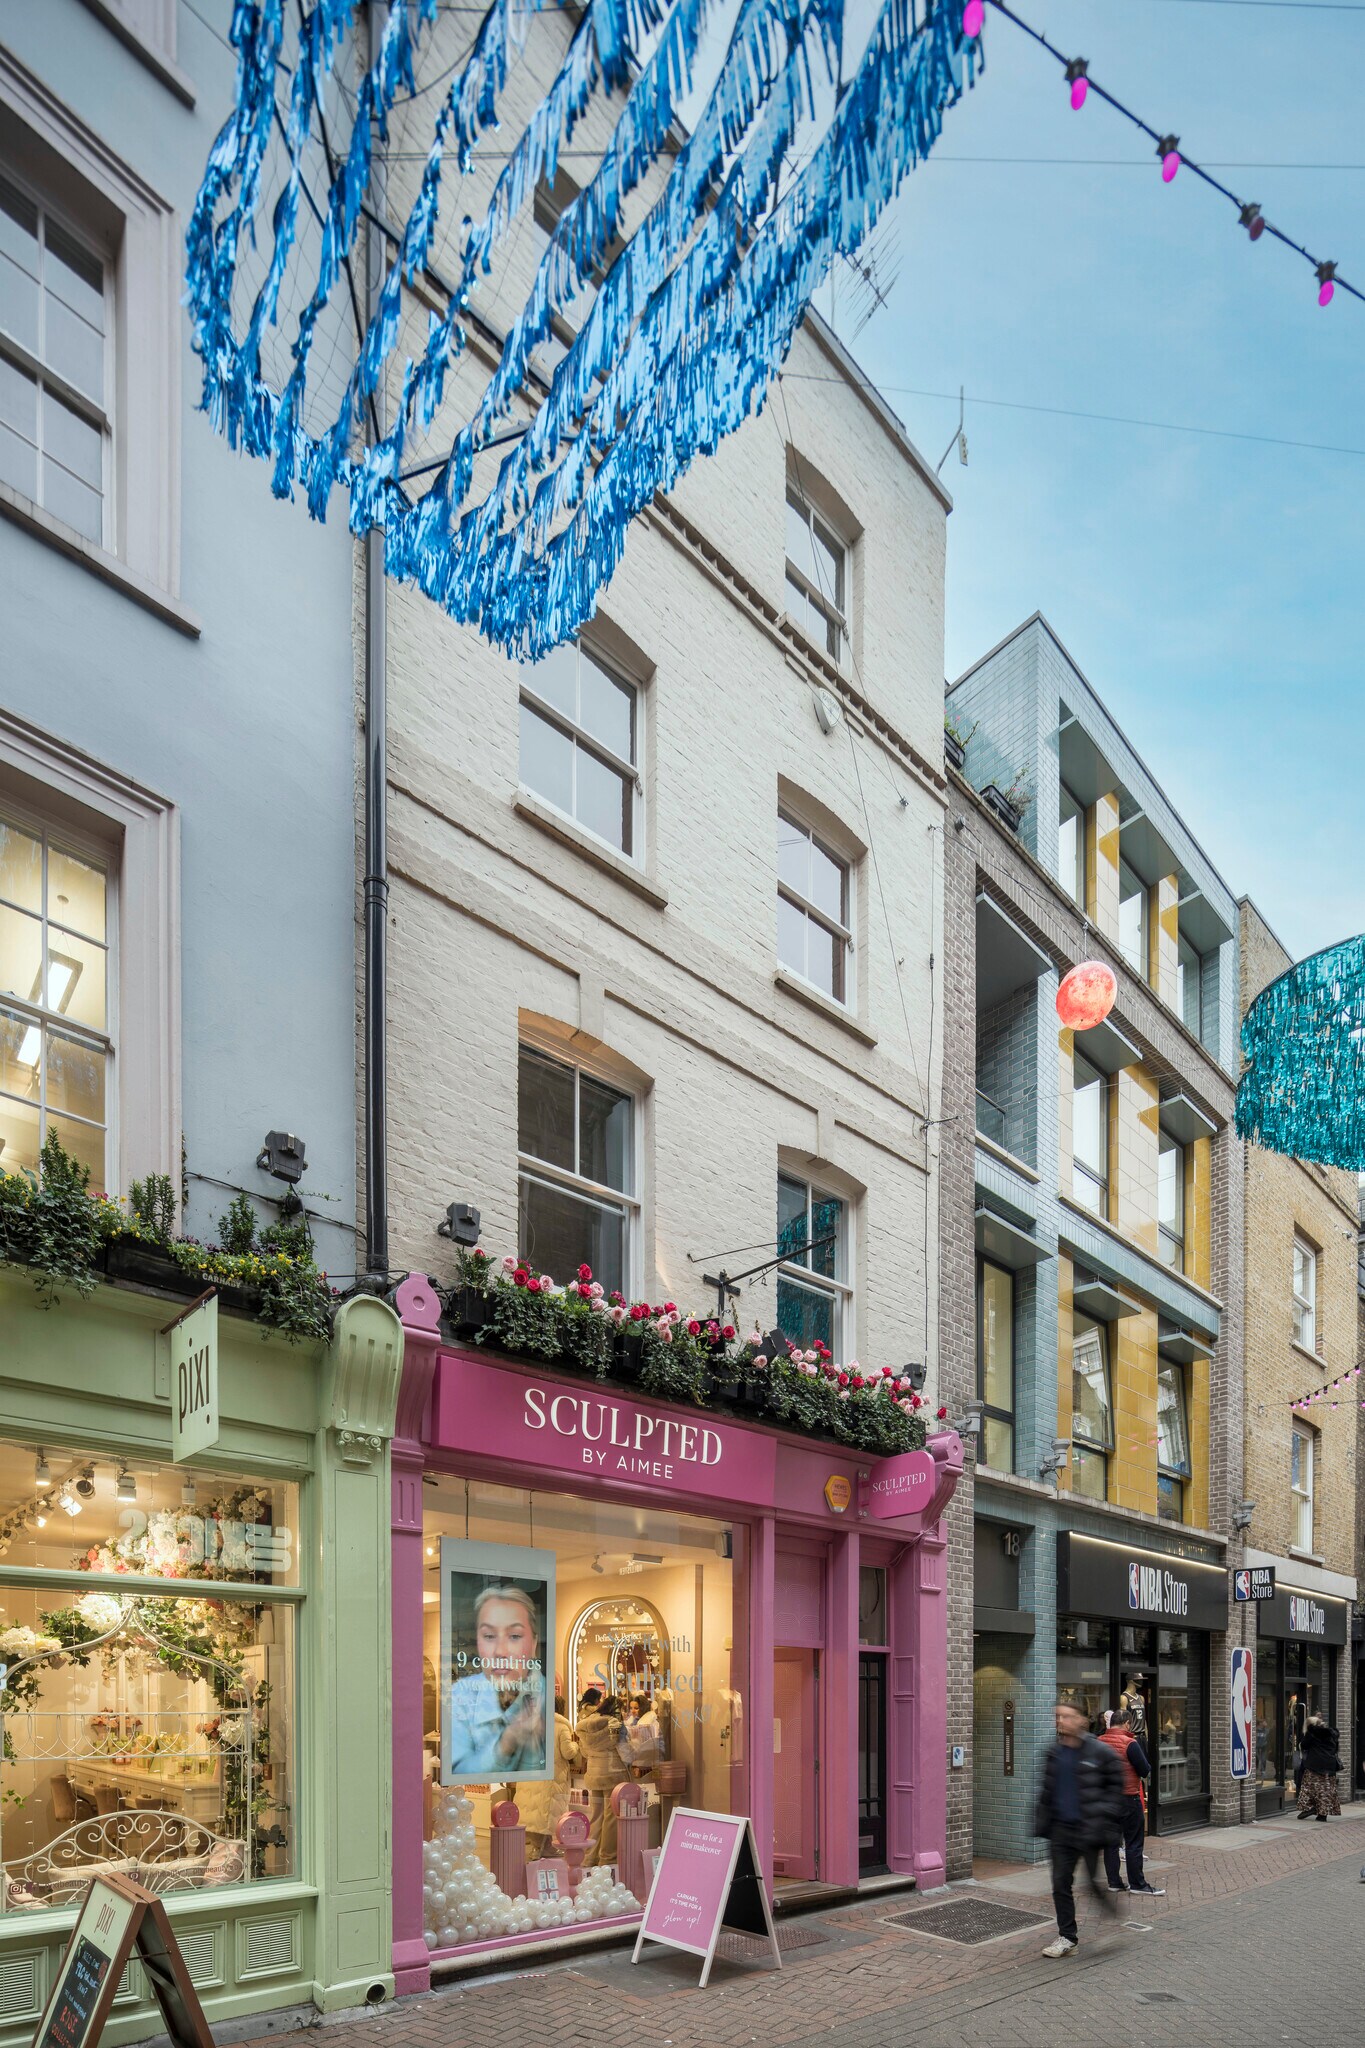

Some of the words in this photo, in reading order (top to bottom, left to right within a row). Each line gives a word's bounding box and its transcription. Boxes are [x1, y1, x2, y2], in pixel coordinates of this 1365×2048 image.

[524, 1388, 723, 1465] SCULPTED
[582, 1448, 607, 1466] BY
[617, 1455, 674, 1479] AIMEE
[872, 1471, 927, 1493] SCULPTED
[895, 1487, 912, 1495] AIMEE
[1002, 1531, 1020, 1557] 18
[1251, 1570, 1270, 1585] NBA
[1139, 1565, 1162, 1613] NBA
[1164, 1570, 1188, 1616] Store
[1251, 1584, 1273, 1600] Store
[1296, 1597, 1310, 1633] NBA
[1310, 1600, 1325, 1635] Store
[659, 1634, 691, 1653] with
[457, 1650, 468, 1668] 9
[472, 1654, 542, 1670] countries
[594, 1662, 704, 1701] Sculpted
[1233, 1748, 1245, 1772] NBA
[685, 1828, 701, 1840] Come
[709, 1833, 719, 1843] for
[680, 1841, 693, 1849] mini
[693, 1842, 722, 1855] makeover
[676, 1892, 699, 1903] CARNABY,
[678, 1899, 688, 1908] TIME
[689, 1902, 698, 1910] FOR
[662, 1910, 684, 1928] glow
